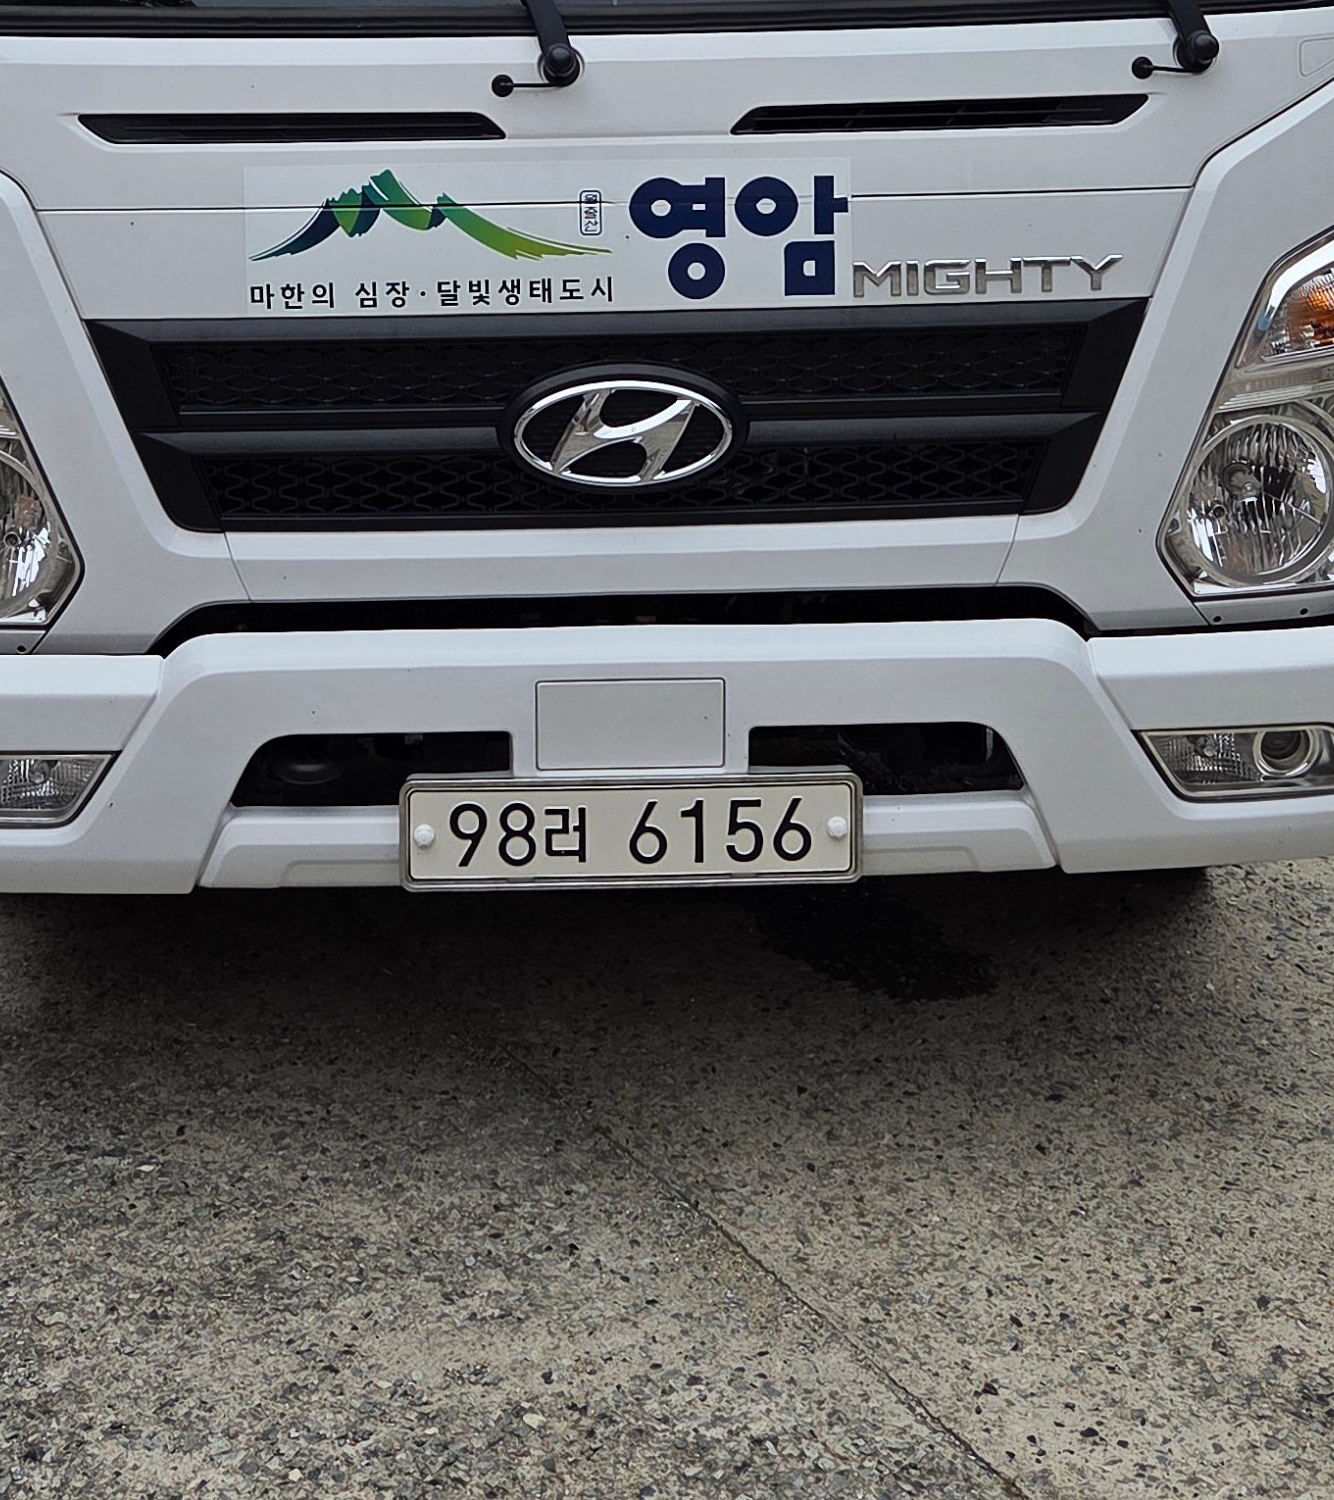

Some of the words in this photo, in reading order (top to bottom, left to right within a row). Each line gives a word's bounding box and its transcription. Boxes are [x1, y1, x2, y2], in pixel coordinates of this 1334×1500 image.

[629, 175, 849, 300] 영암
[250, 282, 336, 310] 마한의
[854, 253, 1123, 299] MIGHTY
[449, 801, 587, 868] 98러
[628, 797, 813, 863] 6156
